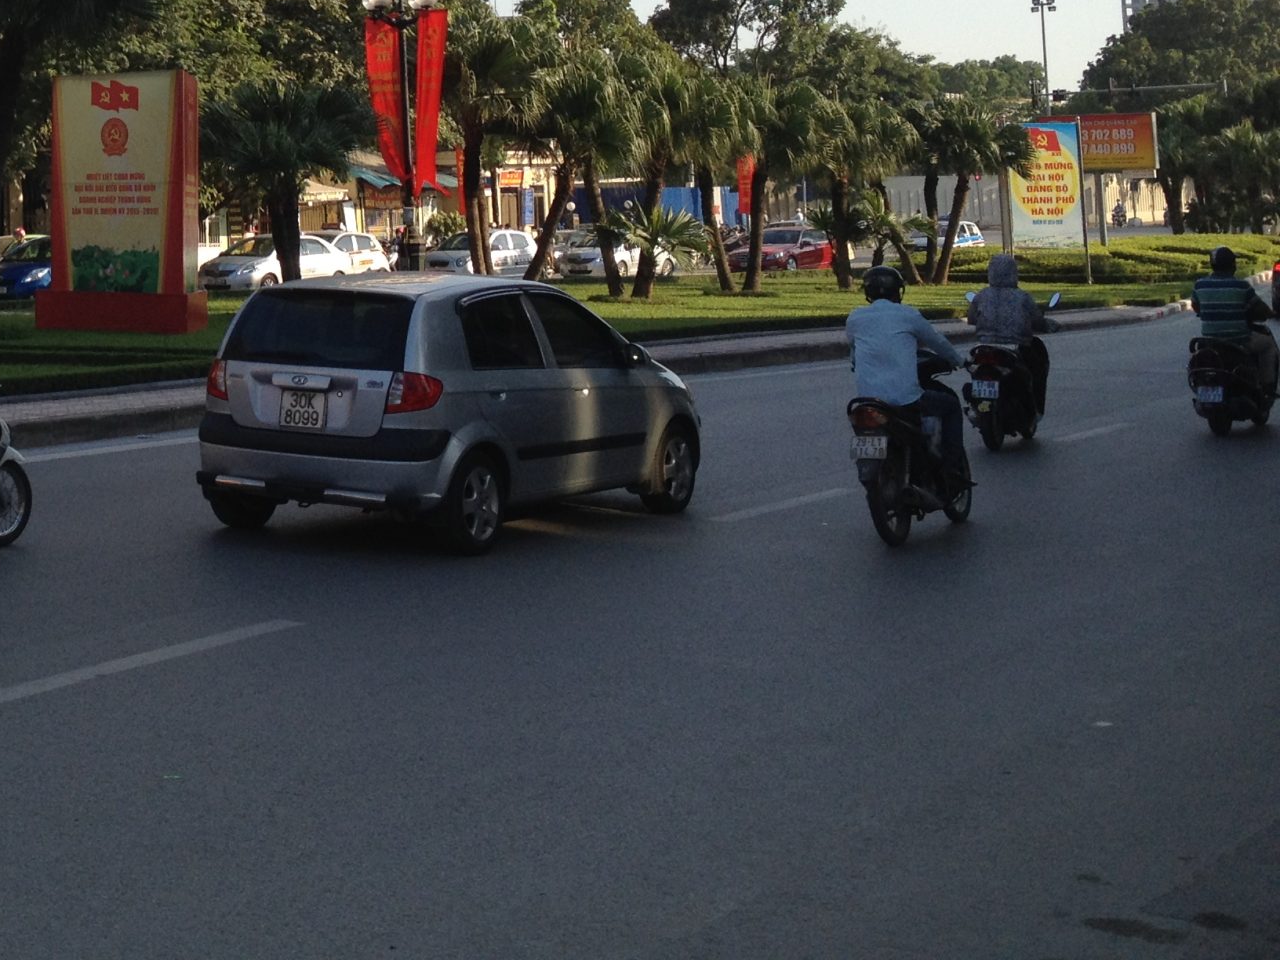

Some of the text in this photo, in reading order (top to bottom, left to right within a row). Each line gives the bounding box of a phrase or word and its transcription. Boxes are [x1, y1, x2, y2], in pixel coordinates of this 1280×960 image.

[1090, 129, 1110, 141] 702
[1112, 128, 1134, 140] 689
[290, 392, 316, 410] 30K
[284, 409, 319, 426] 8099
